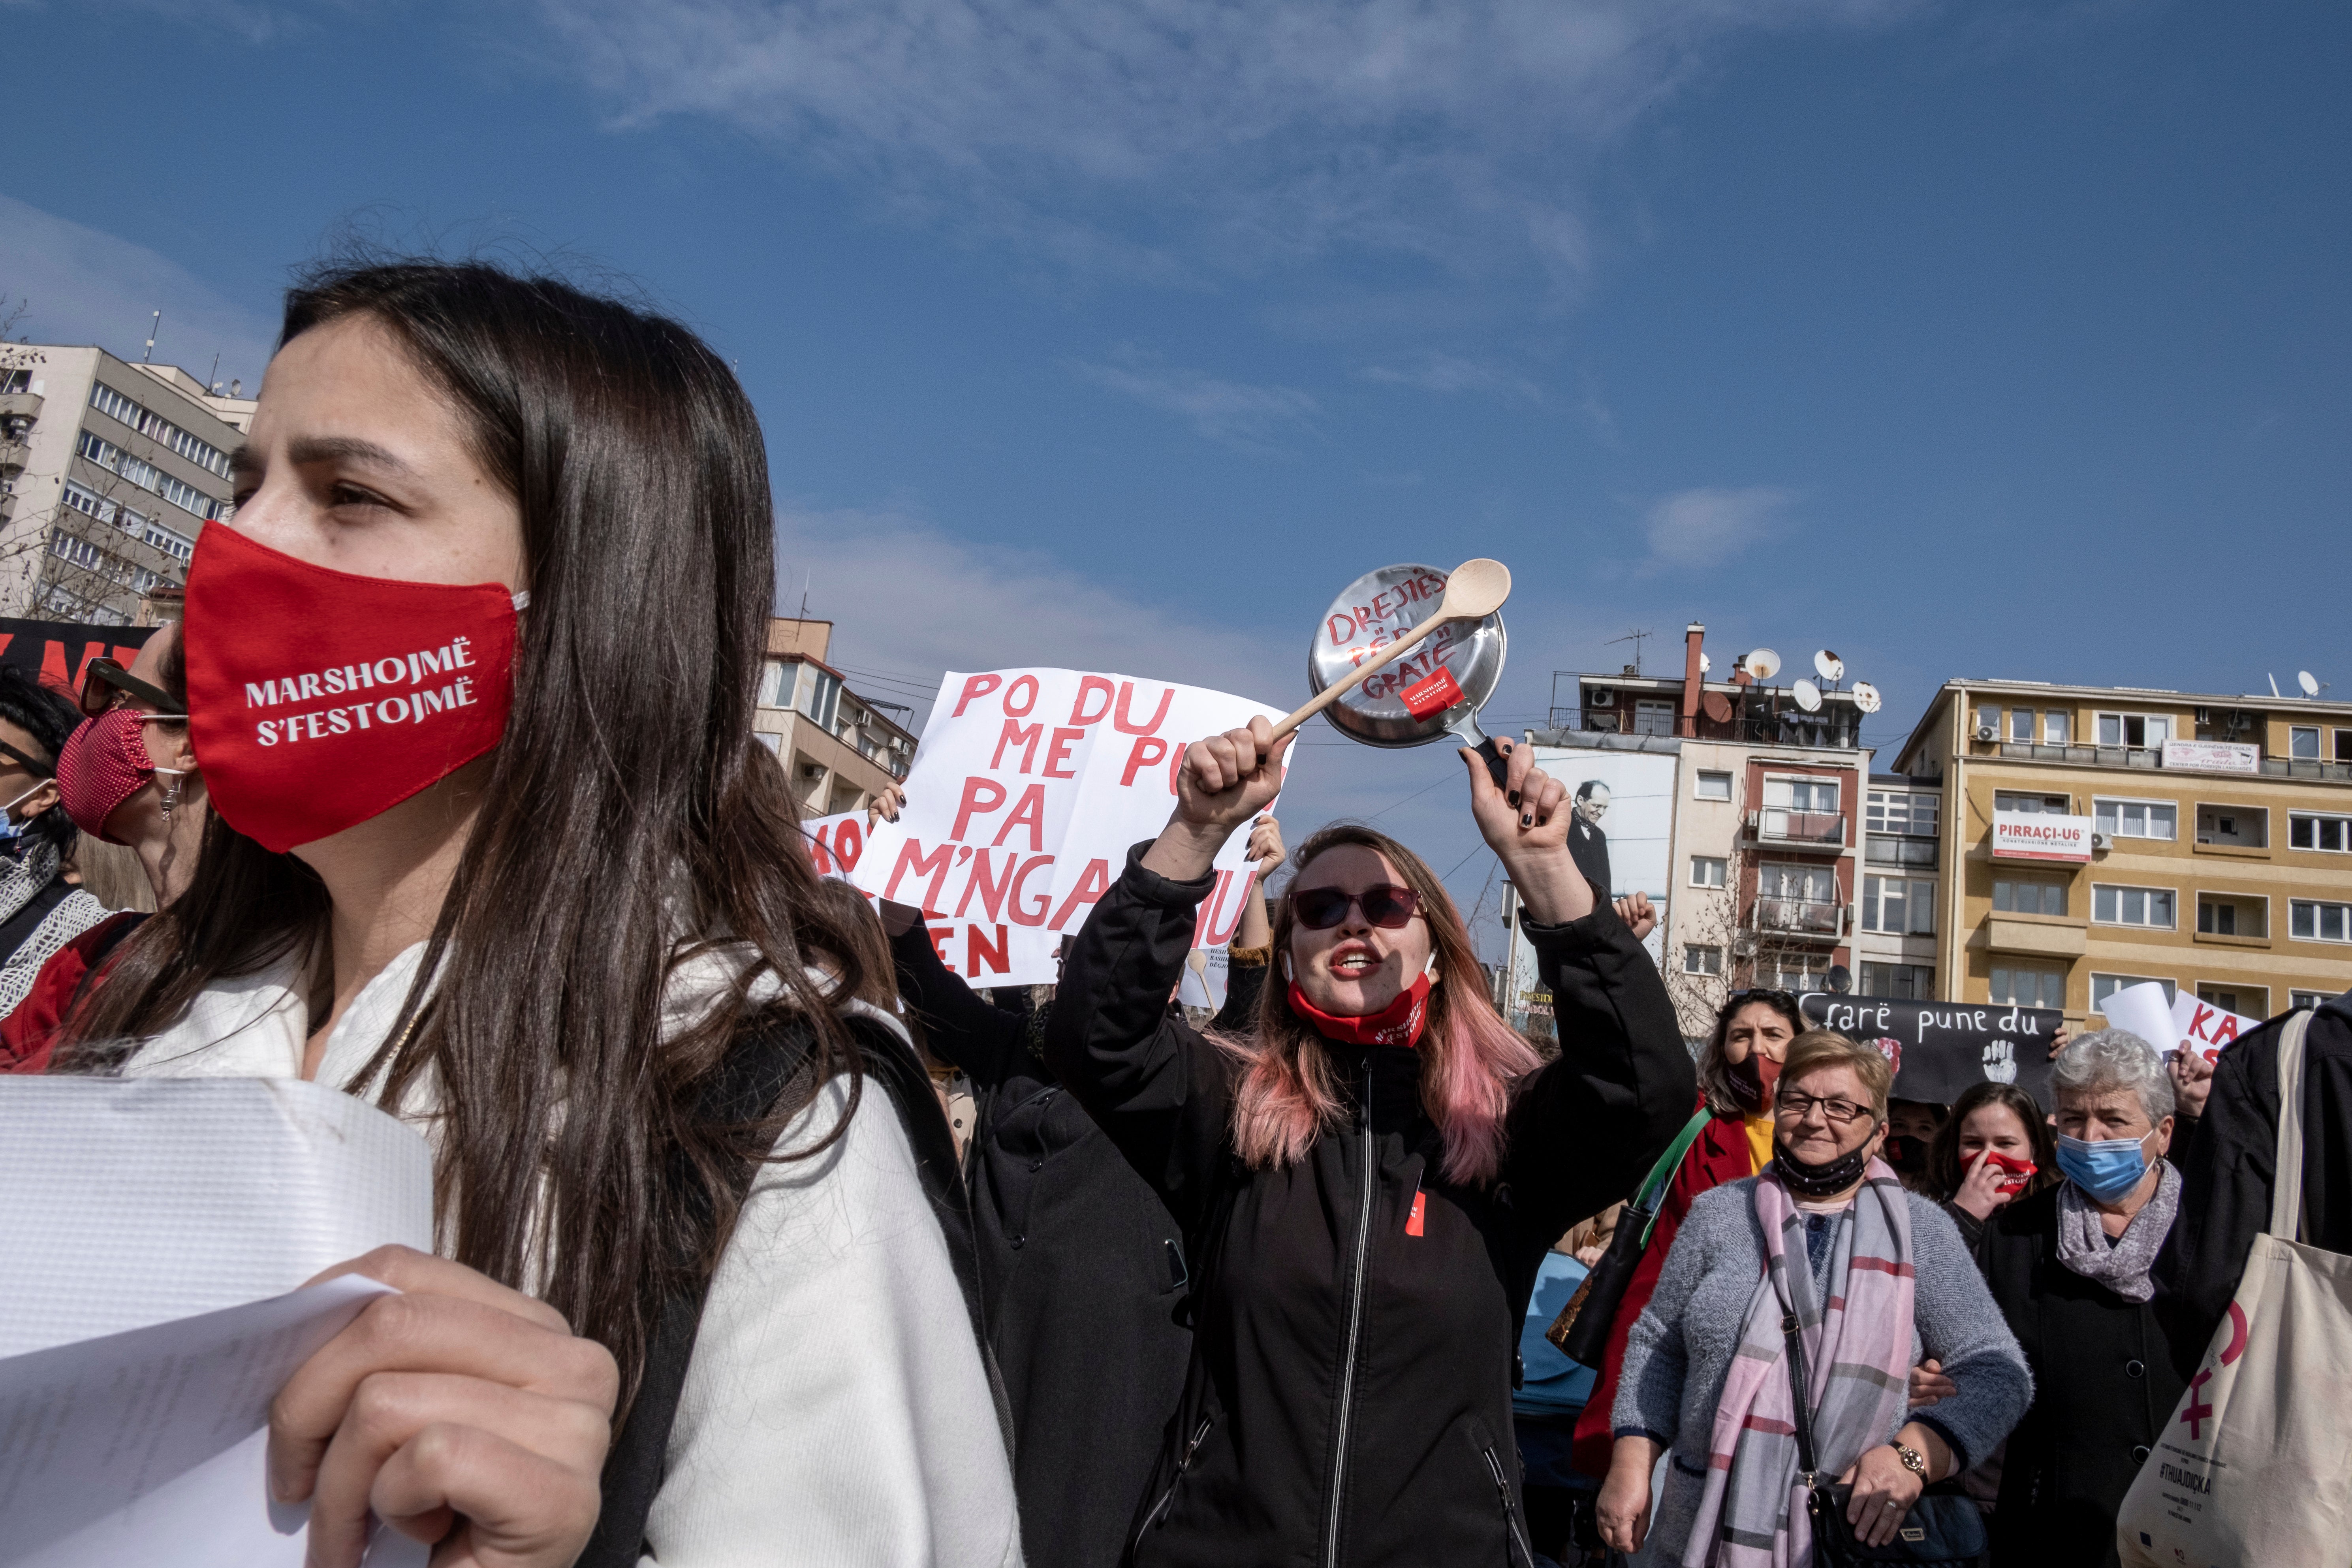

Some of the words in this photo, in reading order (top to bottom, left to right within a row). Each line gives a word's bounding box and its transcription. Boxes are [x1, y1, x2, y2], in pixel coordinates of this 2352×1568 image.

[1327, 568, 1449, 646] DREJTËS
[246, 636, 476, 708] MARSHOJMË
[1362, 626, 1456, 699] GRATË
[257, 675, 478, 746] S'FESTOJMË
[951, 674, 1039, 718] PO
[1068, 675, 1175, 736] DU
[990, 718, 1085, 779] ME
[948, 776, 1045, 852] PA
[1999, 823, 2081, 840] PIRRAÇI-U6
[1918, 1010, 1988, 1043] pune
[1998, 1007, 2040, 1035] du
[2159, 1462, 2211, 1496] #THUAJDIÇKA
